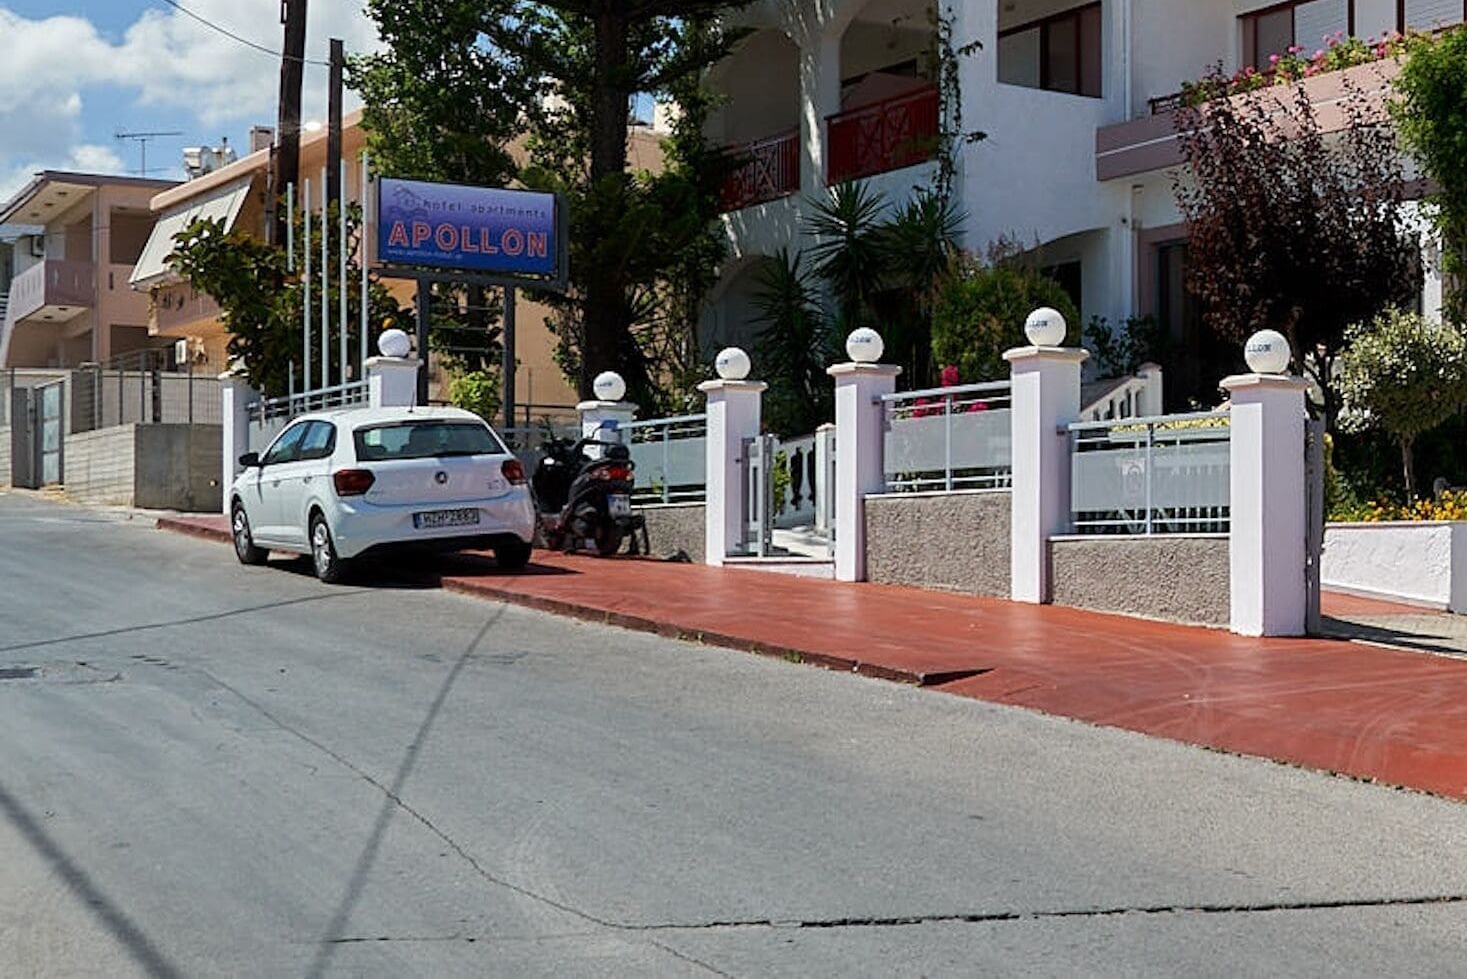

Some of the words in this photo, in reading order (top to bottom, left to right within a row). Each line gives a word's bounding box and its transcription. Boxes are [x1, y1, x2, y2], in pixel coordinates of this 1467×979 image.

[423, 200, 462, 211] hotel
[470, 204, 546, 217] apartments
[388, 221, 548, 258] APOLLON
